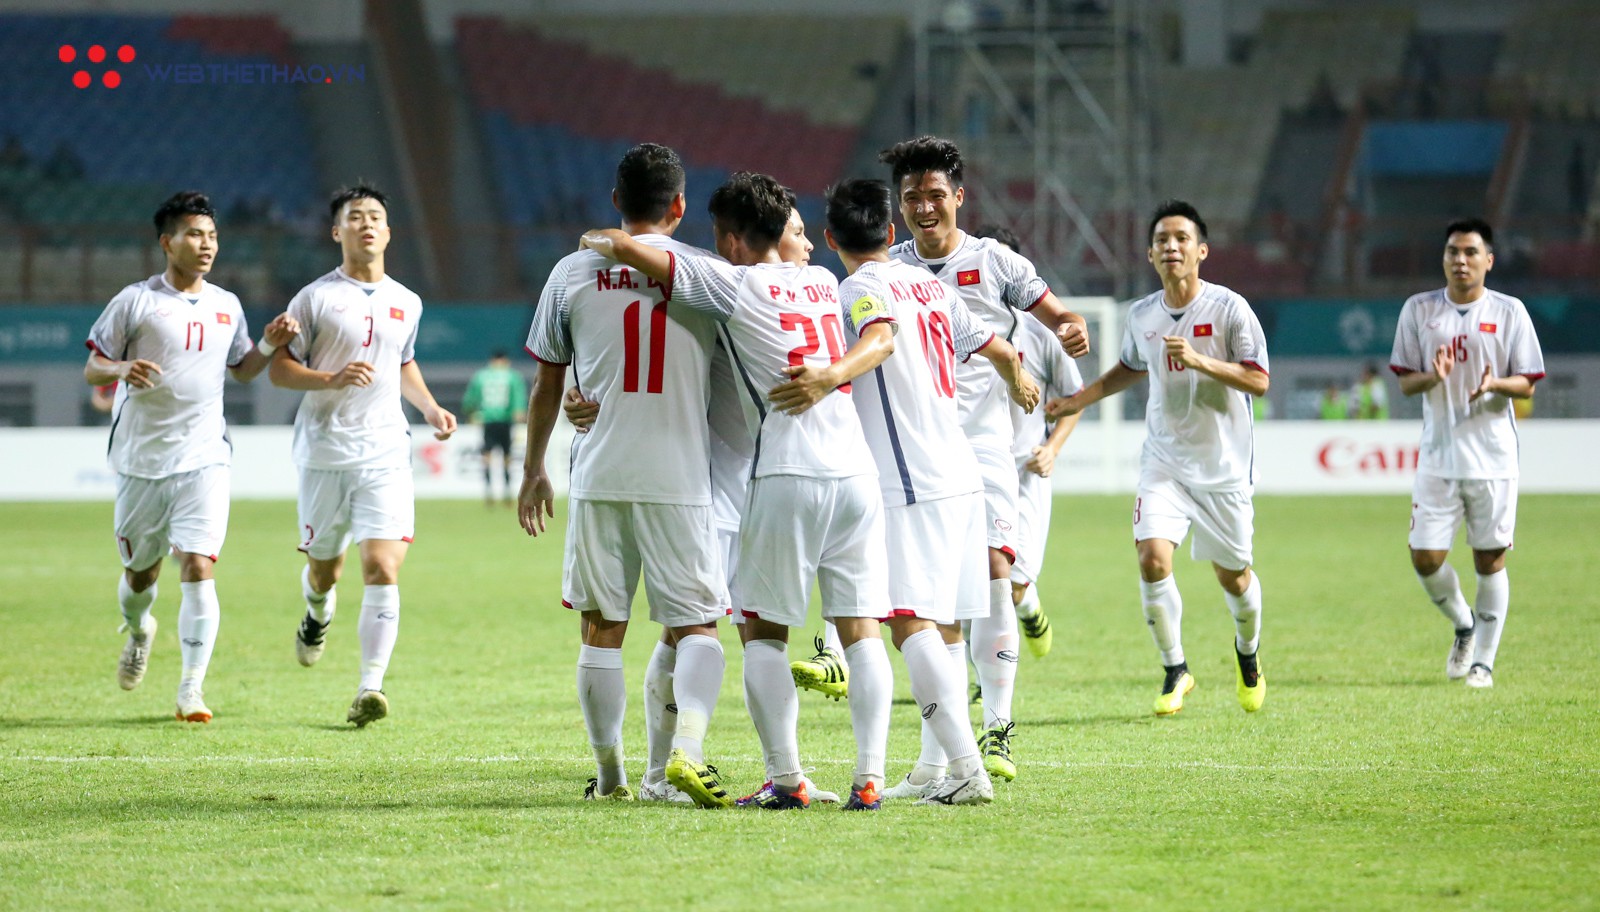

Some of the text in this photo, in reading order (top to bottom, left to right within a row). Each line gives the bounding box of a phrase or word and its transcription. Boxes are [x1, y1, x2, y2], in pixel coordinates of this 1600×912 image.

[597, 268, 639, 291] N.A.
[186, 321, 203, 351] 17
[362, 316, 373, 347] 3
[624, 300, 668, 393] 11
[917, 311, 956, 398] 10
[1452, 334, 1468, 363] 15
